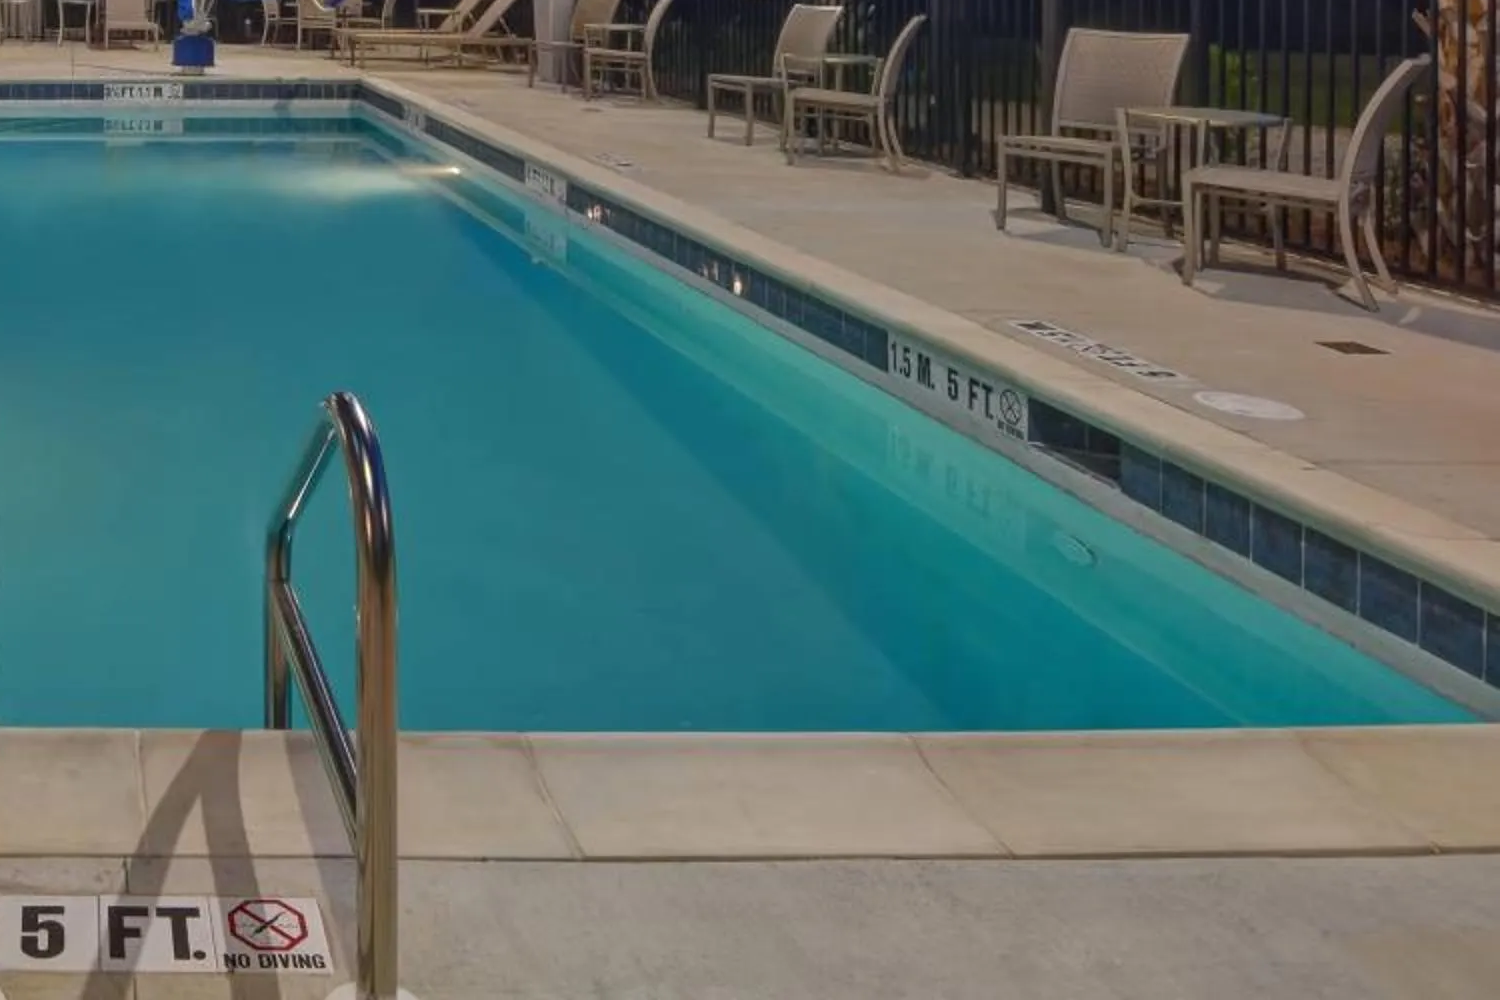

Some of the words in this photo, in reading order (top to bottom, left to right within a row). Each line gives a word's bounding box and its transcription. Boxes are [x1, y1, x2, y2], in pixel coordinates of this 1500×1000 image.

[891, 341, 912, 378] 1.5
[947, 367, 959, 401] 5
[968, 377, 994, 419] FT.
[21, 905, 65, 958] 5
[108, 905, 206, 960] FT.
[224, 953, 251, 969] NO
[258, 953, 326, 969] DIVING
